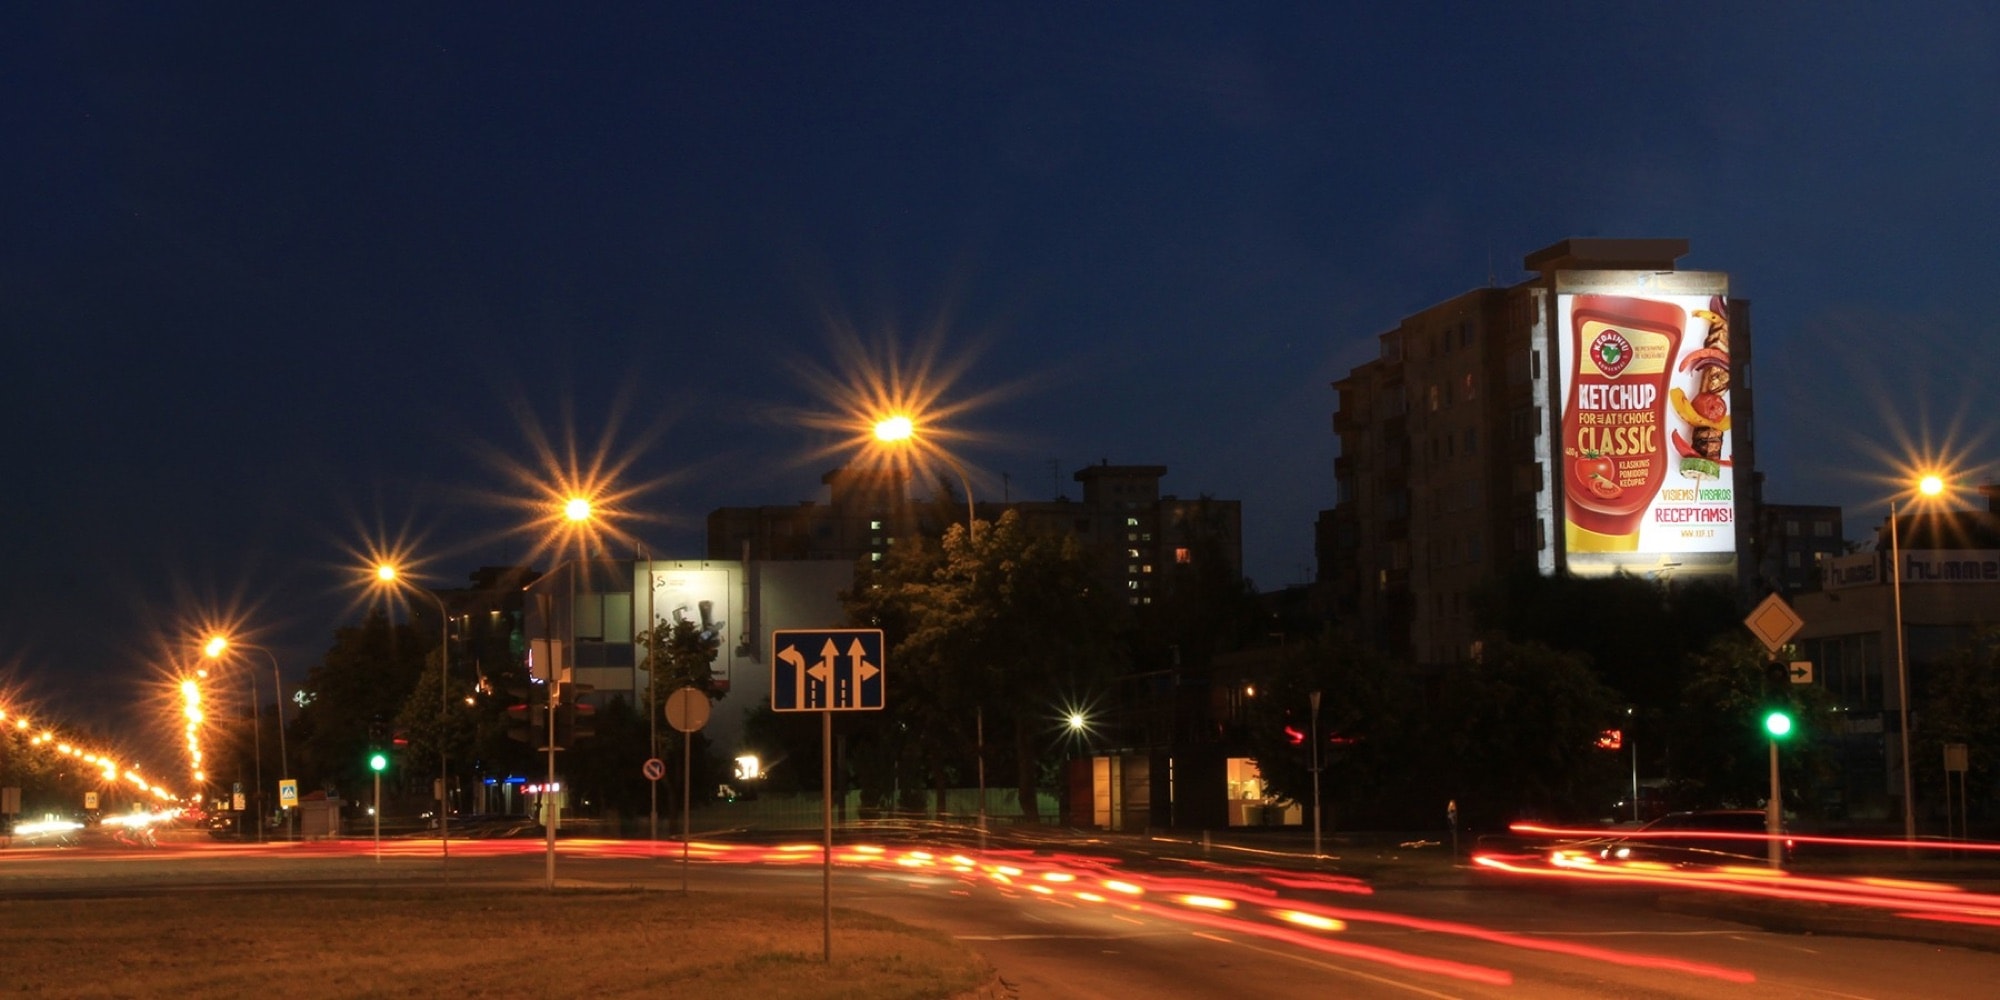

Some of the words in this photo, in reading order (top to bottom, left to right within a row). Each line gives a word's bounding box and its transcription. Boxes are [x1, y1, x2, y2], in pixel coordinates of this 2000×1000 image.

[1578, 383, 1656, 410] KETCHUP
[1579, 412, 1596, 424] FOR
[1605, 413, 1617, 425] AT
[1623, 412, 1655, 424] CHOICE
[1578, 425, 1657, 456] CLASSIC
[1662, 489, 1694, 501] VISIEMS
[1699, 488, 1732, 501] VASAROS
[1655, 507, 1733, 523] RECEPTAMS!
[1906, 554, 2000, 580] humme
